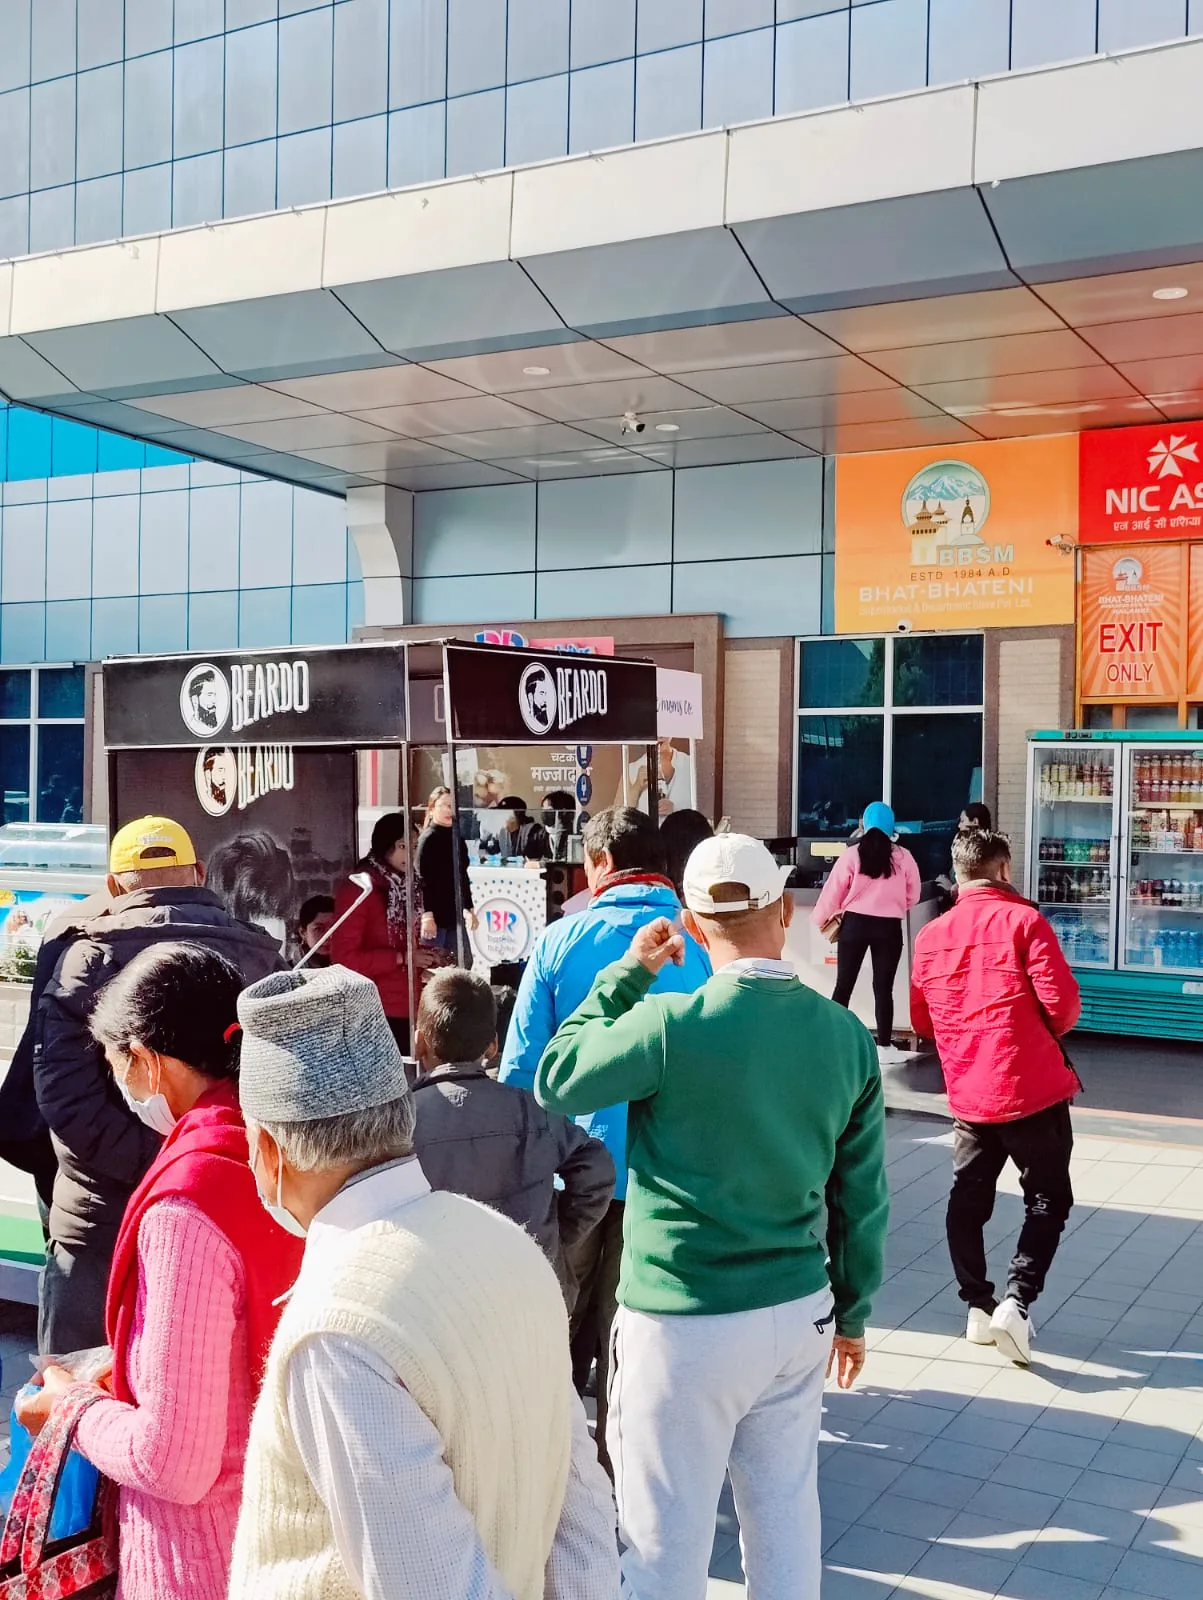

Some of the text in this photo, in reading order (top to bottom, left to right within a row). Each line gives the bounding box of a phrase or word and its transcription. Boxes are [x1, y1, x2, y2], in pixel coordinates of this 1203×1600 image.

[1106, 485, 1160, 514] NIC
[1113, 521, 1128, 531] एन
[1132, 516, 1151, 531] आई
[1154, 516, 1167, 529] सी
[938, 544, 1014, 567] BBSM
[910, 571, 944, 582] ESTD
[954, 569, 982, 579] 1984
[859, 577, 1033, 603] BHAT-BHATENI
[1099, 622, 1163, 654] EXIT
[1106, 663, 1154, 683] ONLY
[230, 660, 309, 732] BEARDO
[556, 667, 607, 730] BEARDO
[237, 745, 295, 810] BEARDO
